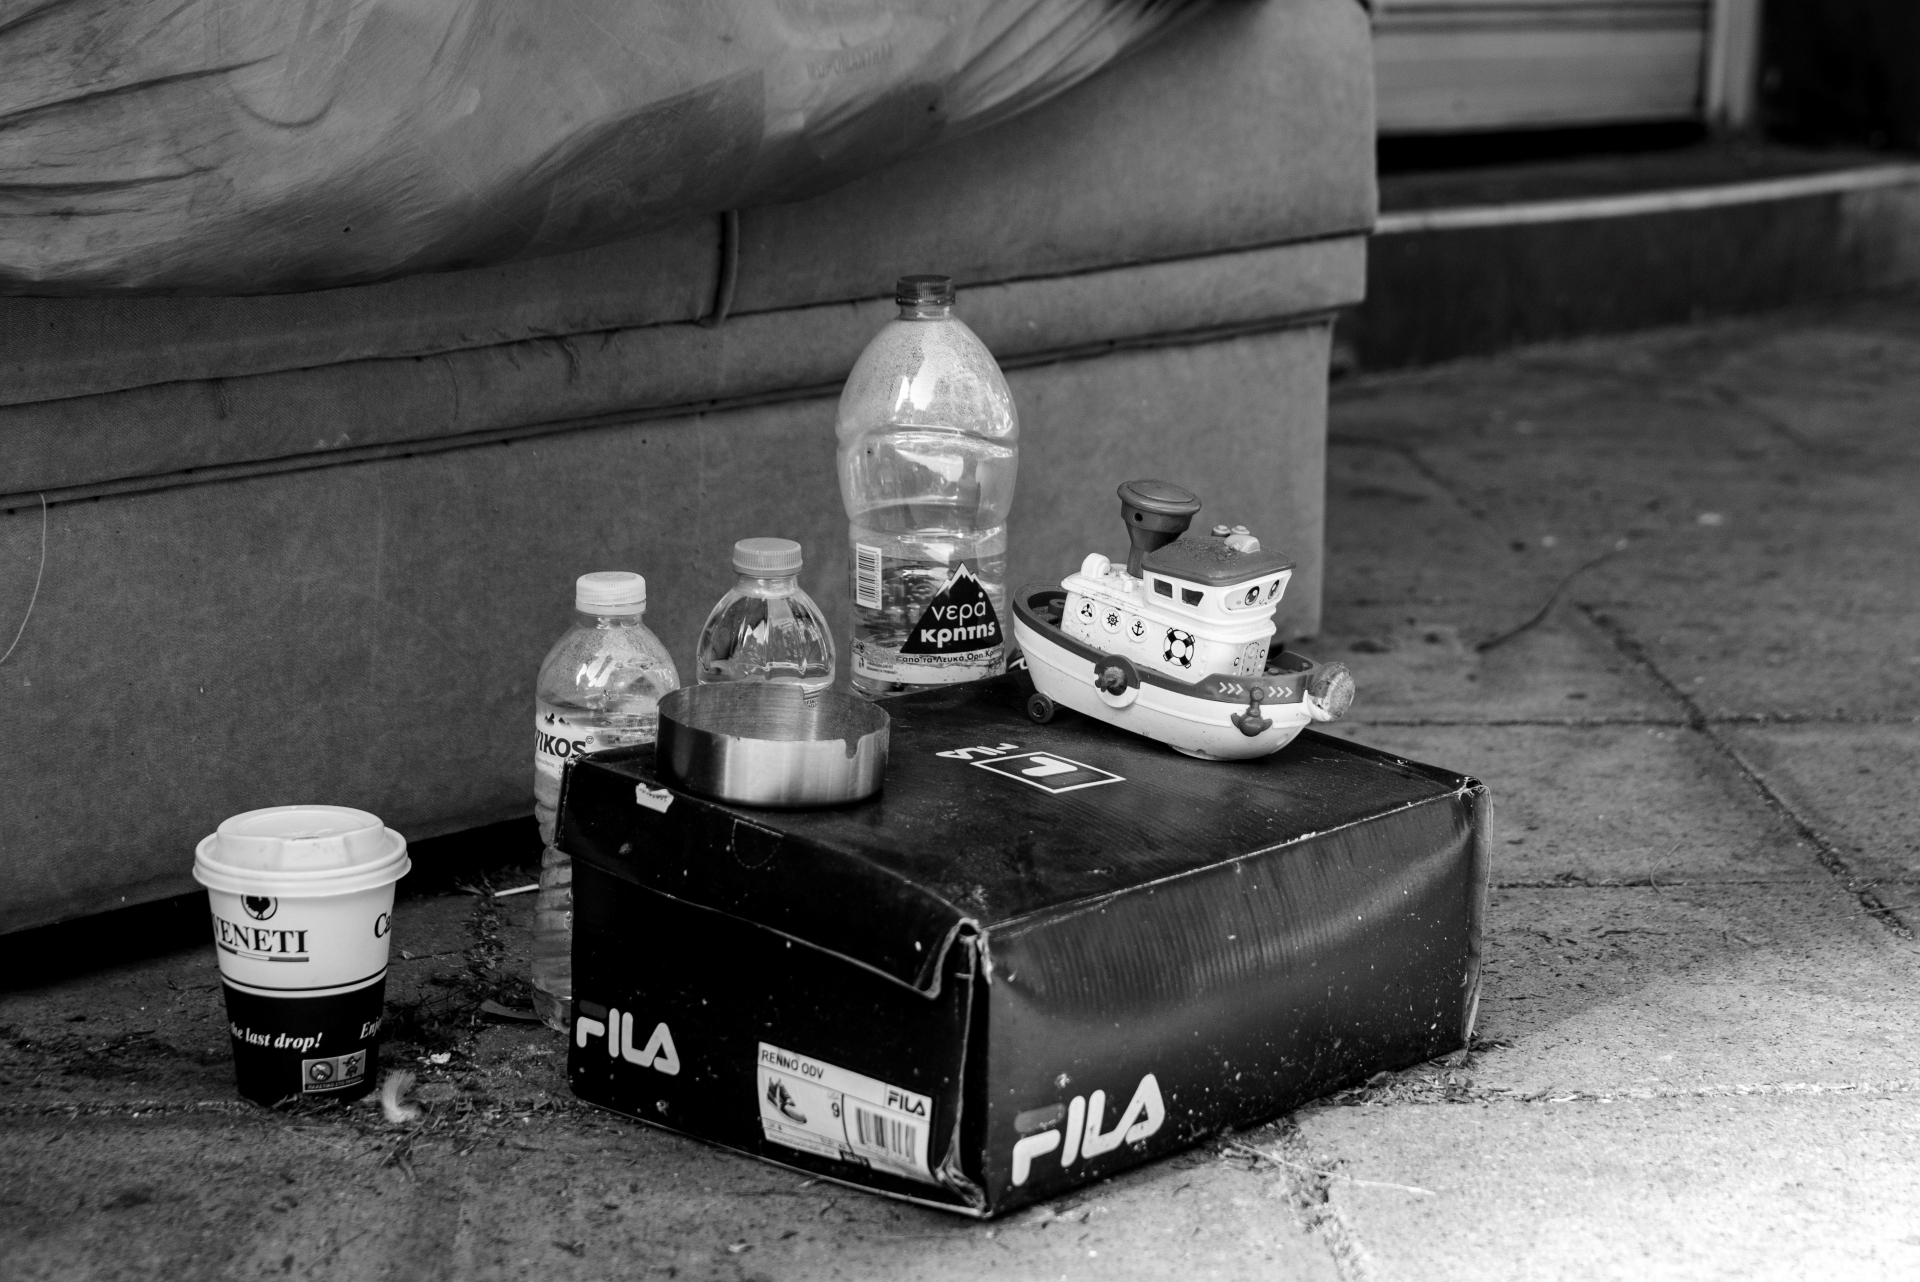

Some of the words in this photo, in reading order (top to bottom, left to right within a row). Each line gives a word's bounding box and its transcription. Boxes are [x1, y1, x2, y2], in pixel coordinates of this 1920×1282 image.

[931, 591, 986, 626] νερά
[245, 1027, 271, 1048] last
[274, 1031, 323, 1054] drop!
[576, 999, 681, 1076] FILA
[761, 1049, 799, 1072] RENNO
[801, 1062, 825, 1080] ODV
[831, 1102, 841, 1119] 9
[887, 1089, 926, 1118] FILA
[1011, 1073, 1166, 1187] FILA
